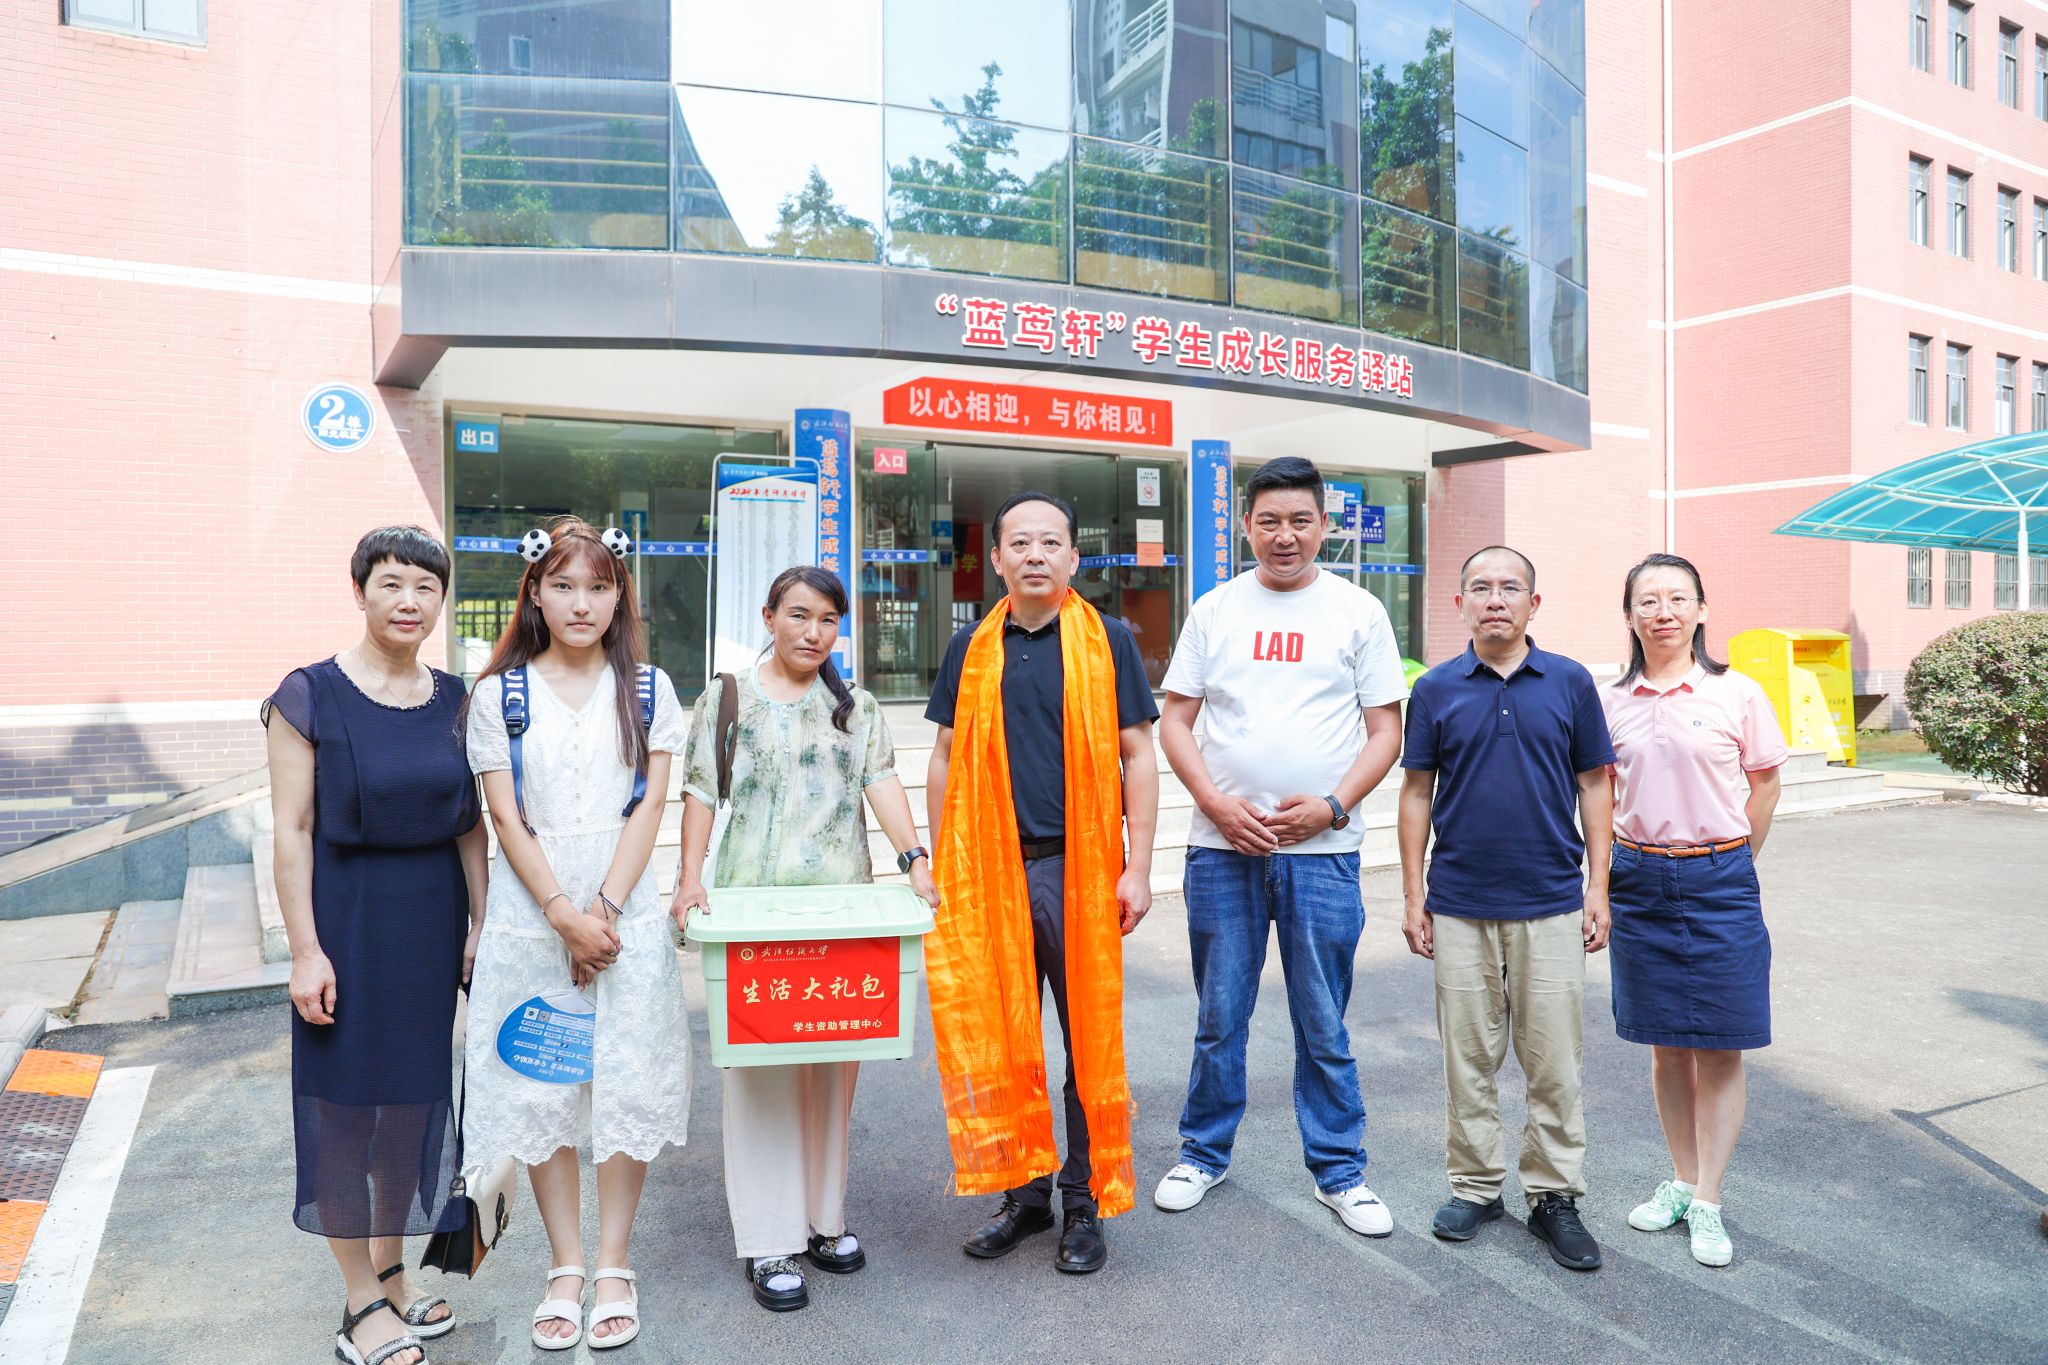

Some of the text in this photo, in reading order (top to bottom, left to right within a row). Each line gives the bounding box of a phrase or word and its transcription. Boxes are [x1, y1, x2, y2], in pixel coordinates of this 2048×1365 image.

[908, 386, 1156, 435] 以心相迎，与你相见！
[461, 428, 495, 446] 出口
[877, 452, 904, 468] 入口
[458, 538, 500, 549] 小心玻璃
[870, 552, 918, 560] 小心玻璃
[1253, 631, 1304, 662] LAD
[742, 973, 885, 1004] 生活大礼包
[793, 1018, 883, 1032] 学生资助管理中心
